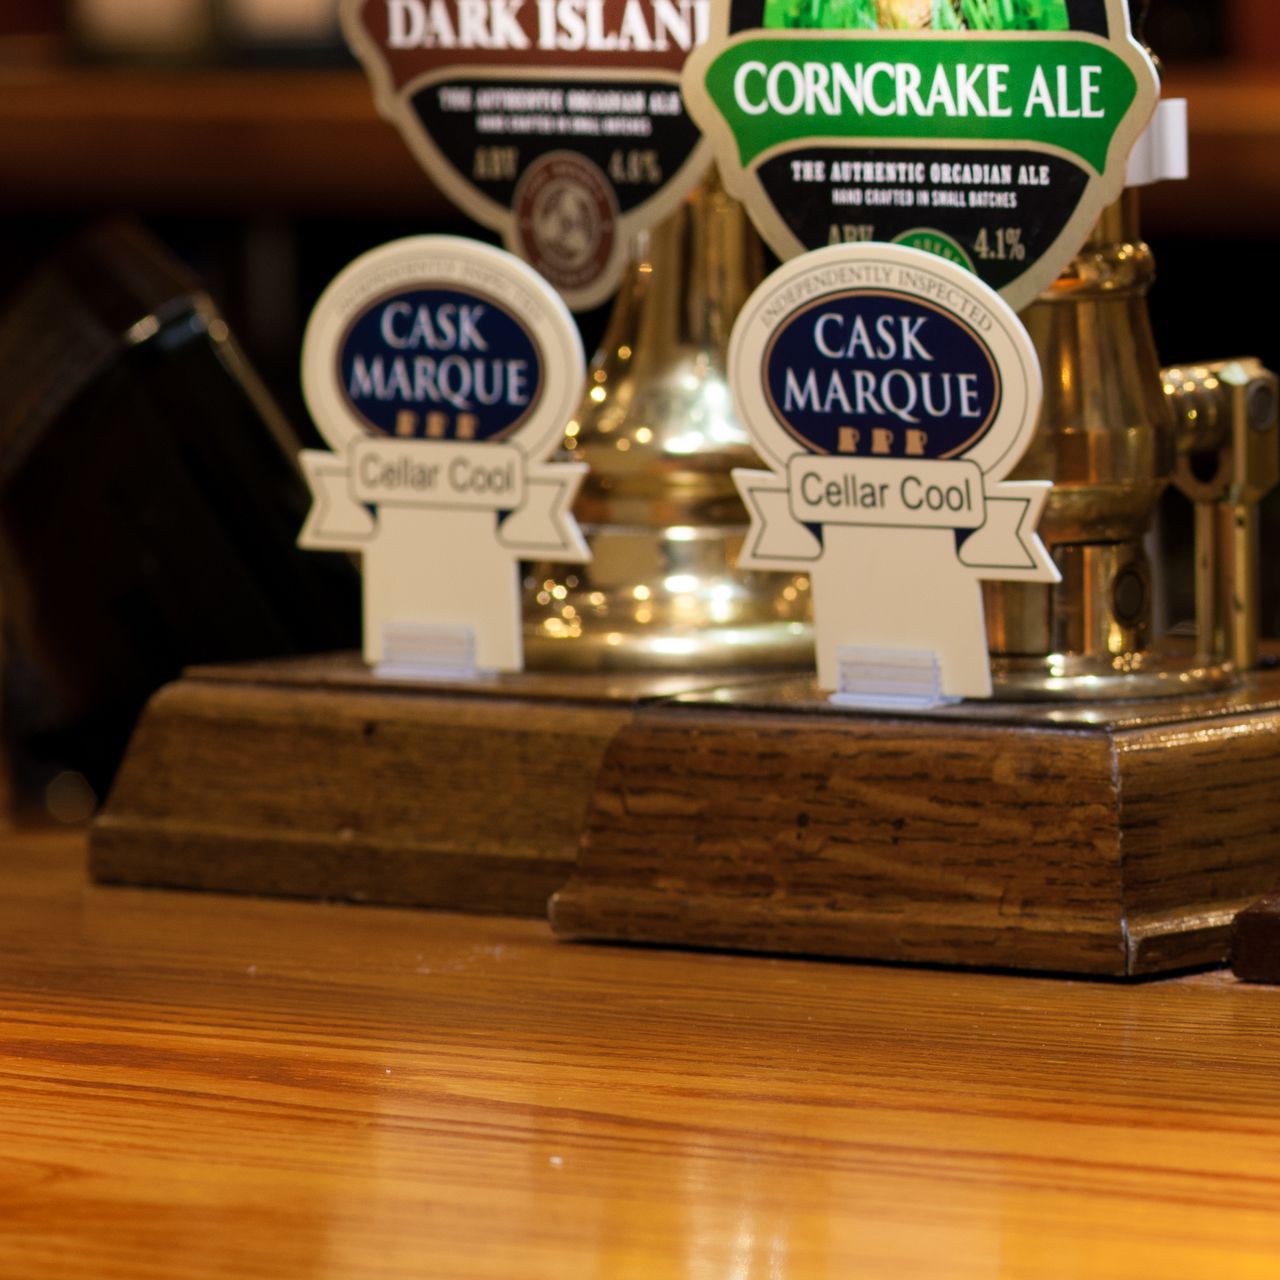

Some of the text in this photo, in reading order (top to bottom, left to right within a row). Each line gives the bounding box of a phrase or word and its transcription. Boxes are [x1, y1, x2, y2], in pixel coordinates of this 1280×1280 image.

[734, 60, 1012, 117] CORNCRAKE
[1023, 64, 1105, 118] ALE
[791, 160, 1050, 185] THE AUTHENTIC ORCADIAN ALE
[973, 227, 1026, 261] 4.1%
[899, 266, 993, 332] INSPECTED
[381, 301, 489, 352] CASK
[814, 313, 934, 361] CASK
[350, 354, 529, 410] MARQUE
[783, 367, 981, 423] MARQUE
[360, 453, 514, 493] Cellar Cool
[800, 472, 972, 511] Cellar Cool
